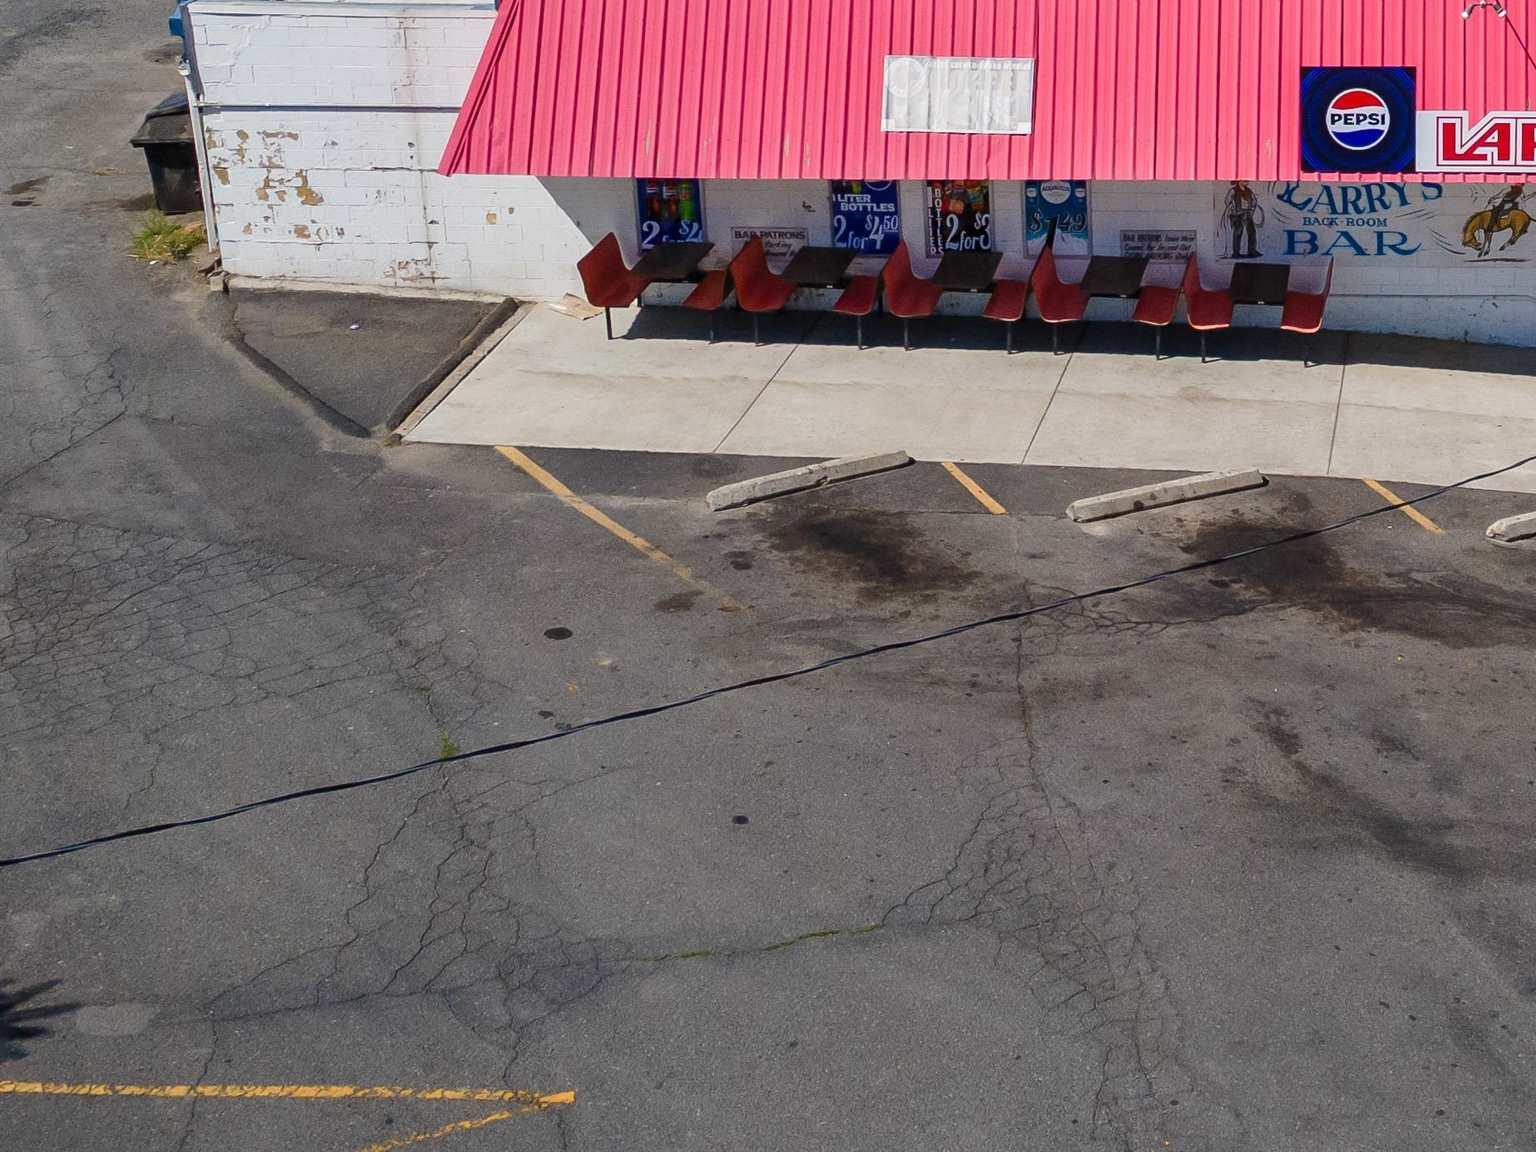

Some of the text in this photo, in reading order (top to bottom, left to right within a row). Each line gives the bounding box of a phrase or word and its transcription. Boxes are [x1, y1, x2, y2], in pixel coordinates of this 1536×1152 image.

[1330, 112, 1387, 126] PEPSI
[838, 194, 872, 202] LITER
[841, 202, 895, 212] BOTTLES
[1277, 181, 1443, 215] LARRYS
[642, 220, 661, 248] 2
[760, 230, 806, 240] PATRONS
[834, 214, 847, 247] 2
[847, 230, 869, 250] for
[945, 214, 960, 250] 2
[960, 230, 980, 251] for
[1282, 229, 1422, 256] BAR
